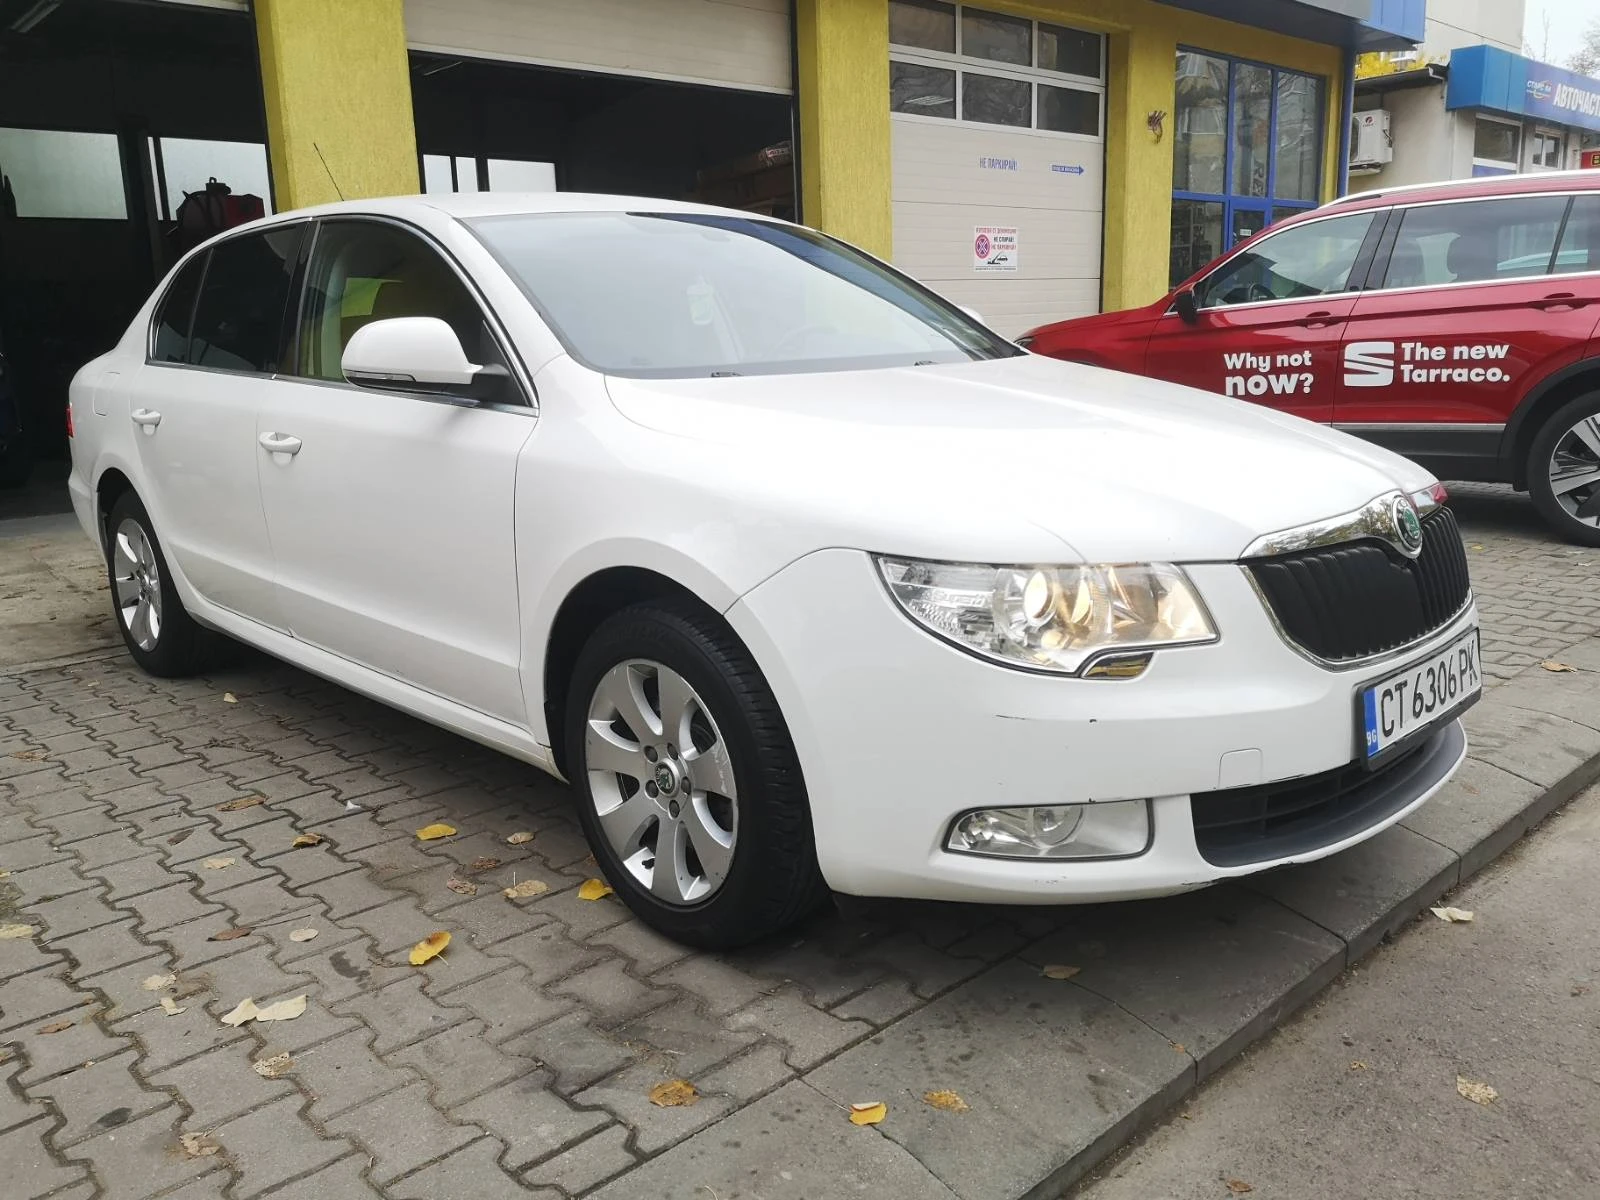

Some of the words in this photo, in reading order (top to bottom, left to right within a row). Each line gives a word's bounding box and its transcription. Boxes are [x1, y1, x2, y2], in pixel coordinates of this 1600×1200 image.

[1401, 342, 1447, 361] The
[1453, 344, 1510, 360] new
[1223, 352, 1271, 373] Why
[1276, 350, 1312, 368] not
[1400, 364, 1510, 383] Tarraco.
[1225, 373, 1314, 396] now?
[1366, 729, 1377, 746] BG
